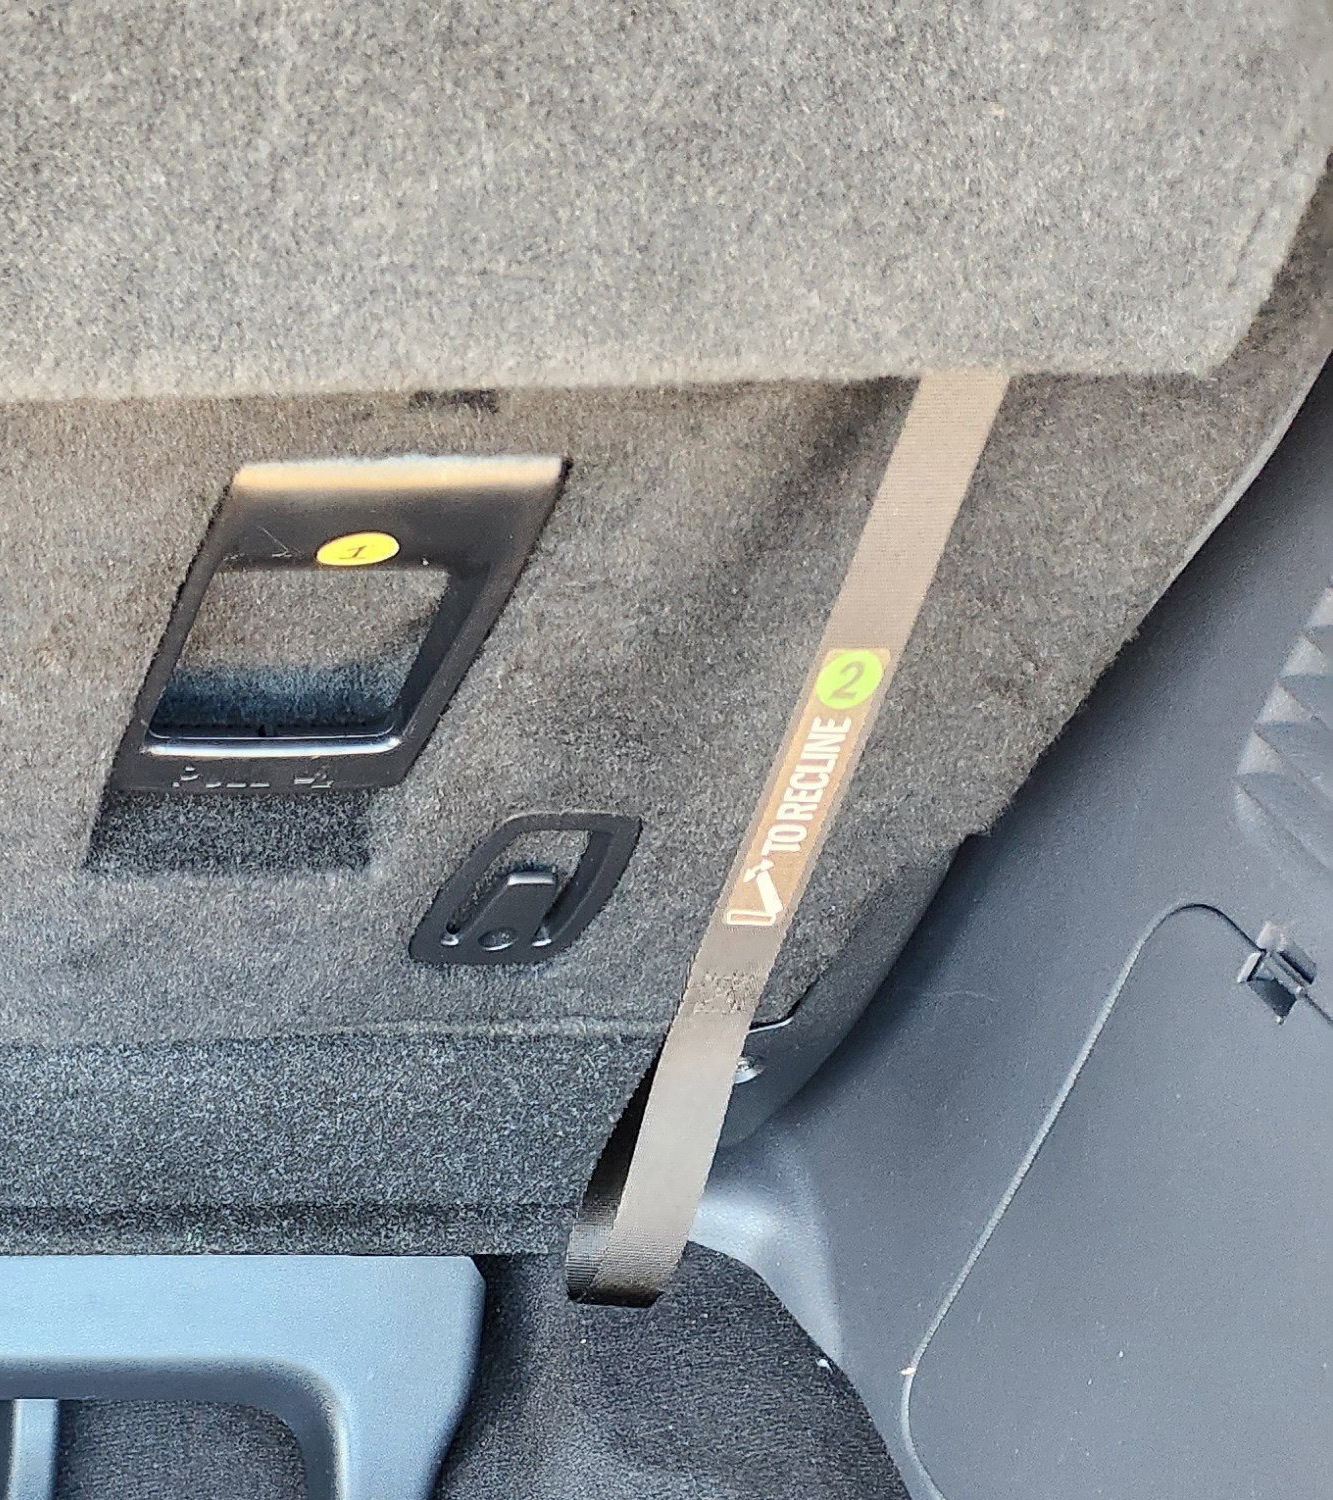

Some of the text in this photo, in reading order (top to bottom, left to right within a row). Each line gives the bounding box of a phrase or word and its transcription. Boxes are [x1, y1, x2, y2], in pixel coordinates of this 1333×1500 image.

[829, 660, 865, 700] 2
[761, 716, 852, 855] TO RECLINE
